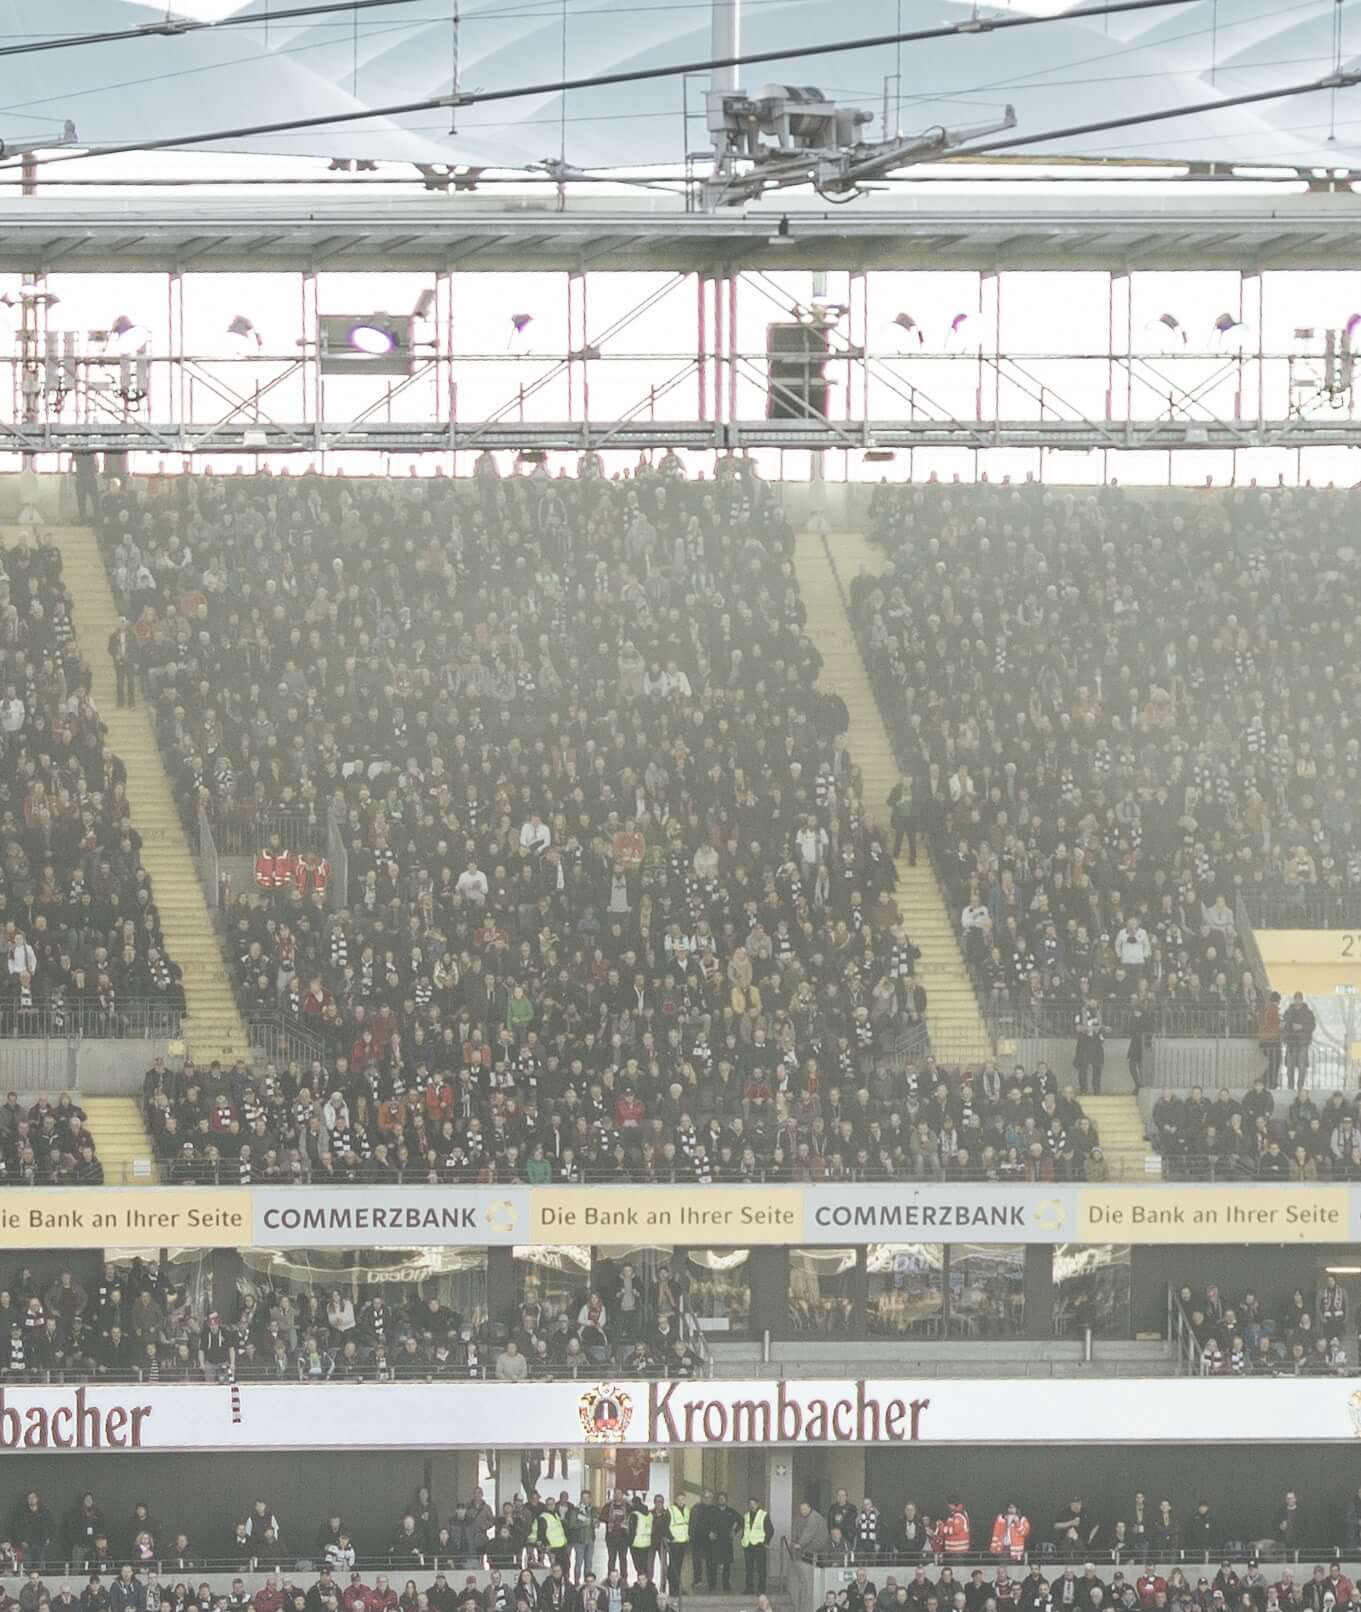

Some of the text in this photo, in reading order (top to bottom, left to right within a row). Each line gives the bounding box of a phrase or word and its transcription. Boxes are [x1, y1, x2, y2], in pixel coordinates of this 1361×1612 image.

[1342, 934, 1361, 957] 2
[29, 1209, 83, 1229] Bank
[92, 1213, 117, 1228] an
[127, 1209, 180, 1228] Ihrer
[188, 1208, 243, 1227] Seite
[263, 1208, 476, 1229] COMMERZBANK
[541, 1205, 794, 1226] Die Bank an Ihrer Seite
[815, 1205, 1025, 1227] COMMERZBANK
[1088, 1205, 1339, 1225] Die Bank an Ihrer Seite
[647, 1381, 930, 1442] Krombacher
